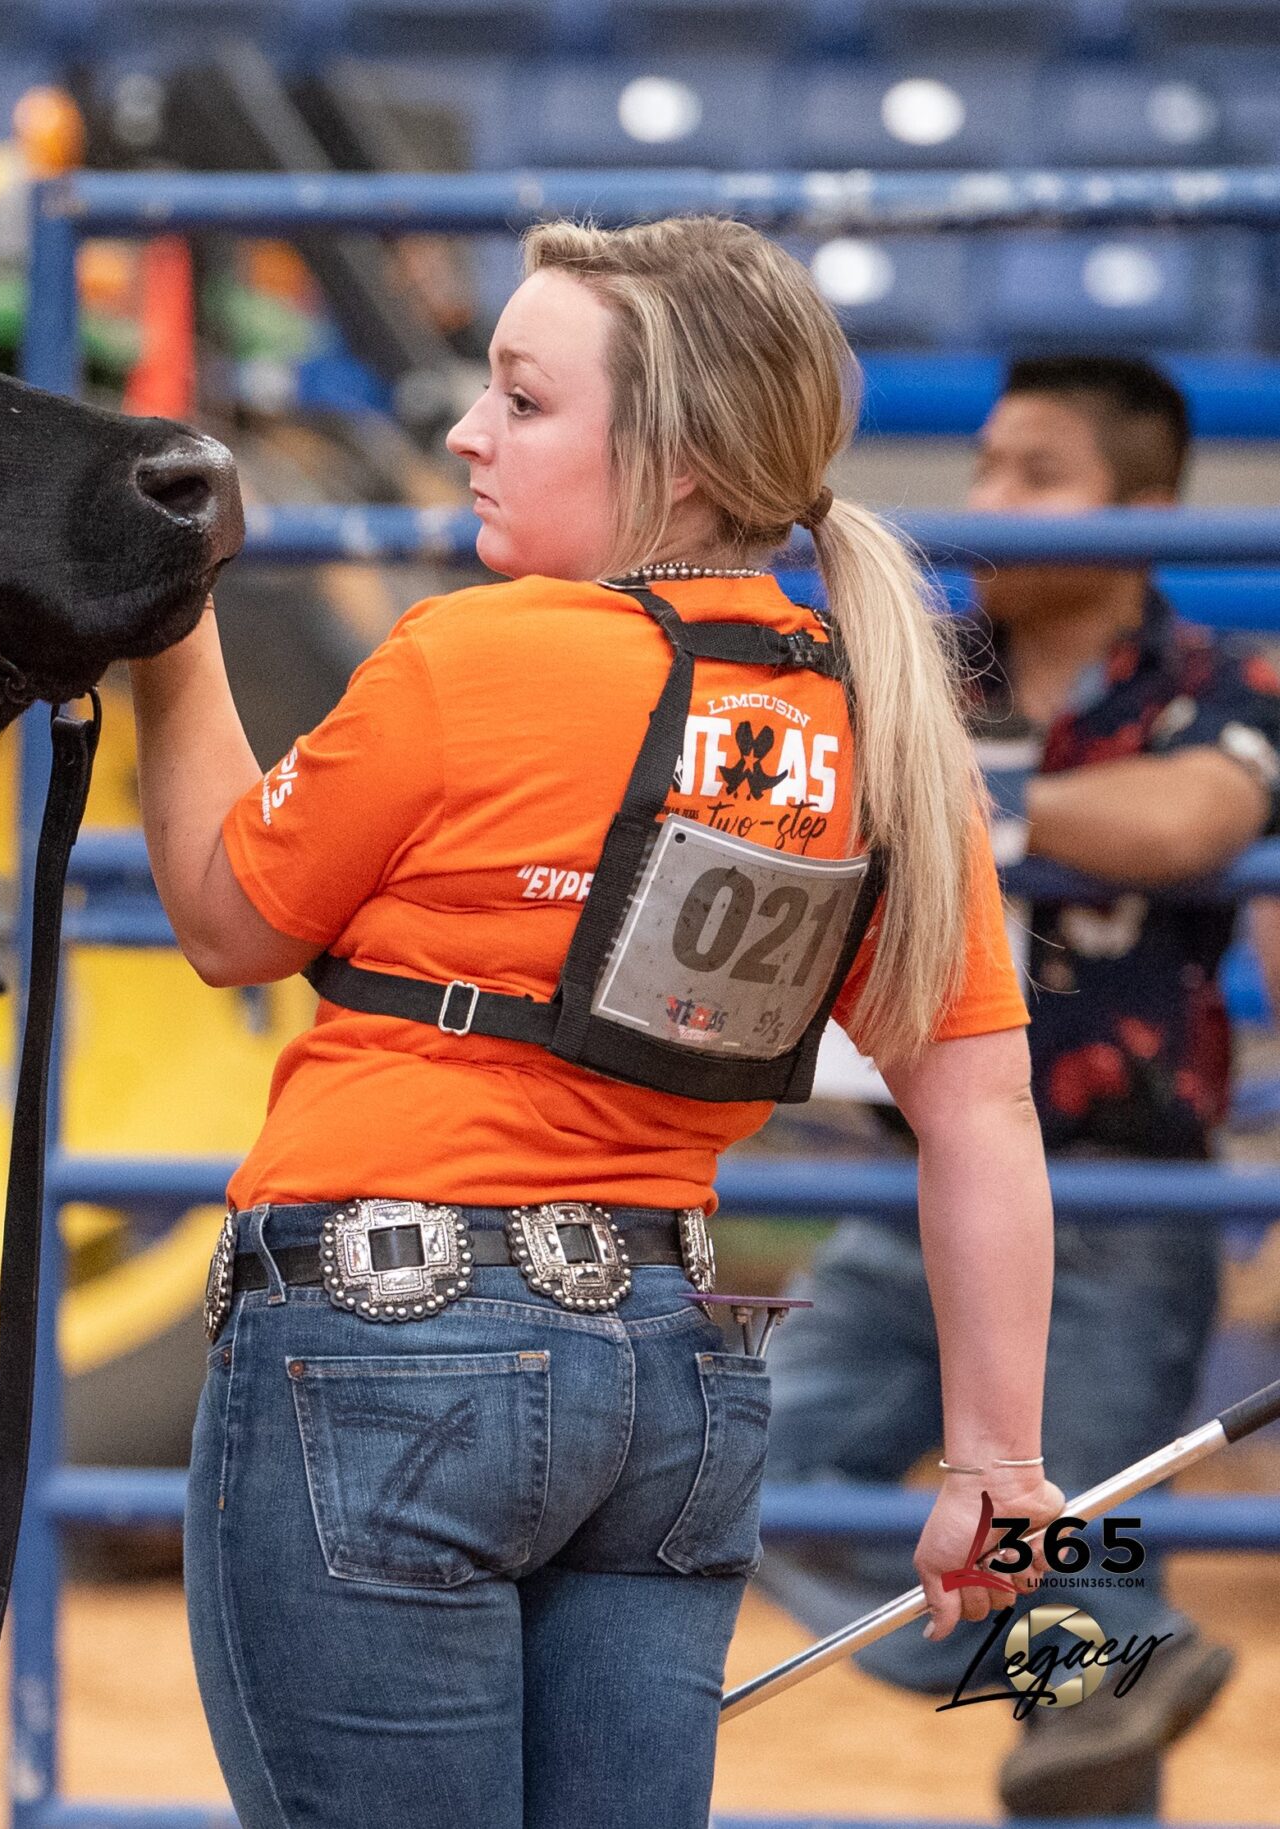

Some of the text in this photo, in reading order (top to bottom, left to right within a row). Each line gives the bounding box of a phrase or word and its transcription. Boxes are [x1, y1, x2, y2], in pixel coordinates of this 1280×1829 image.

[707, 693, 811, 728] LIMOUSIN
[680, 714, 839, 814] TEXAS
[707, 799, 827, 855] two-step
[672, 866, 842, 987] 021
